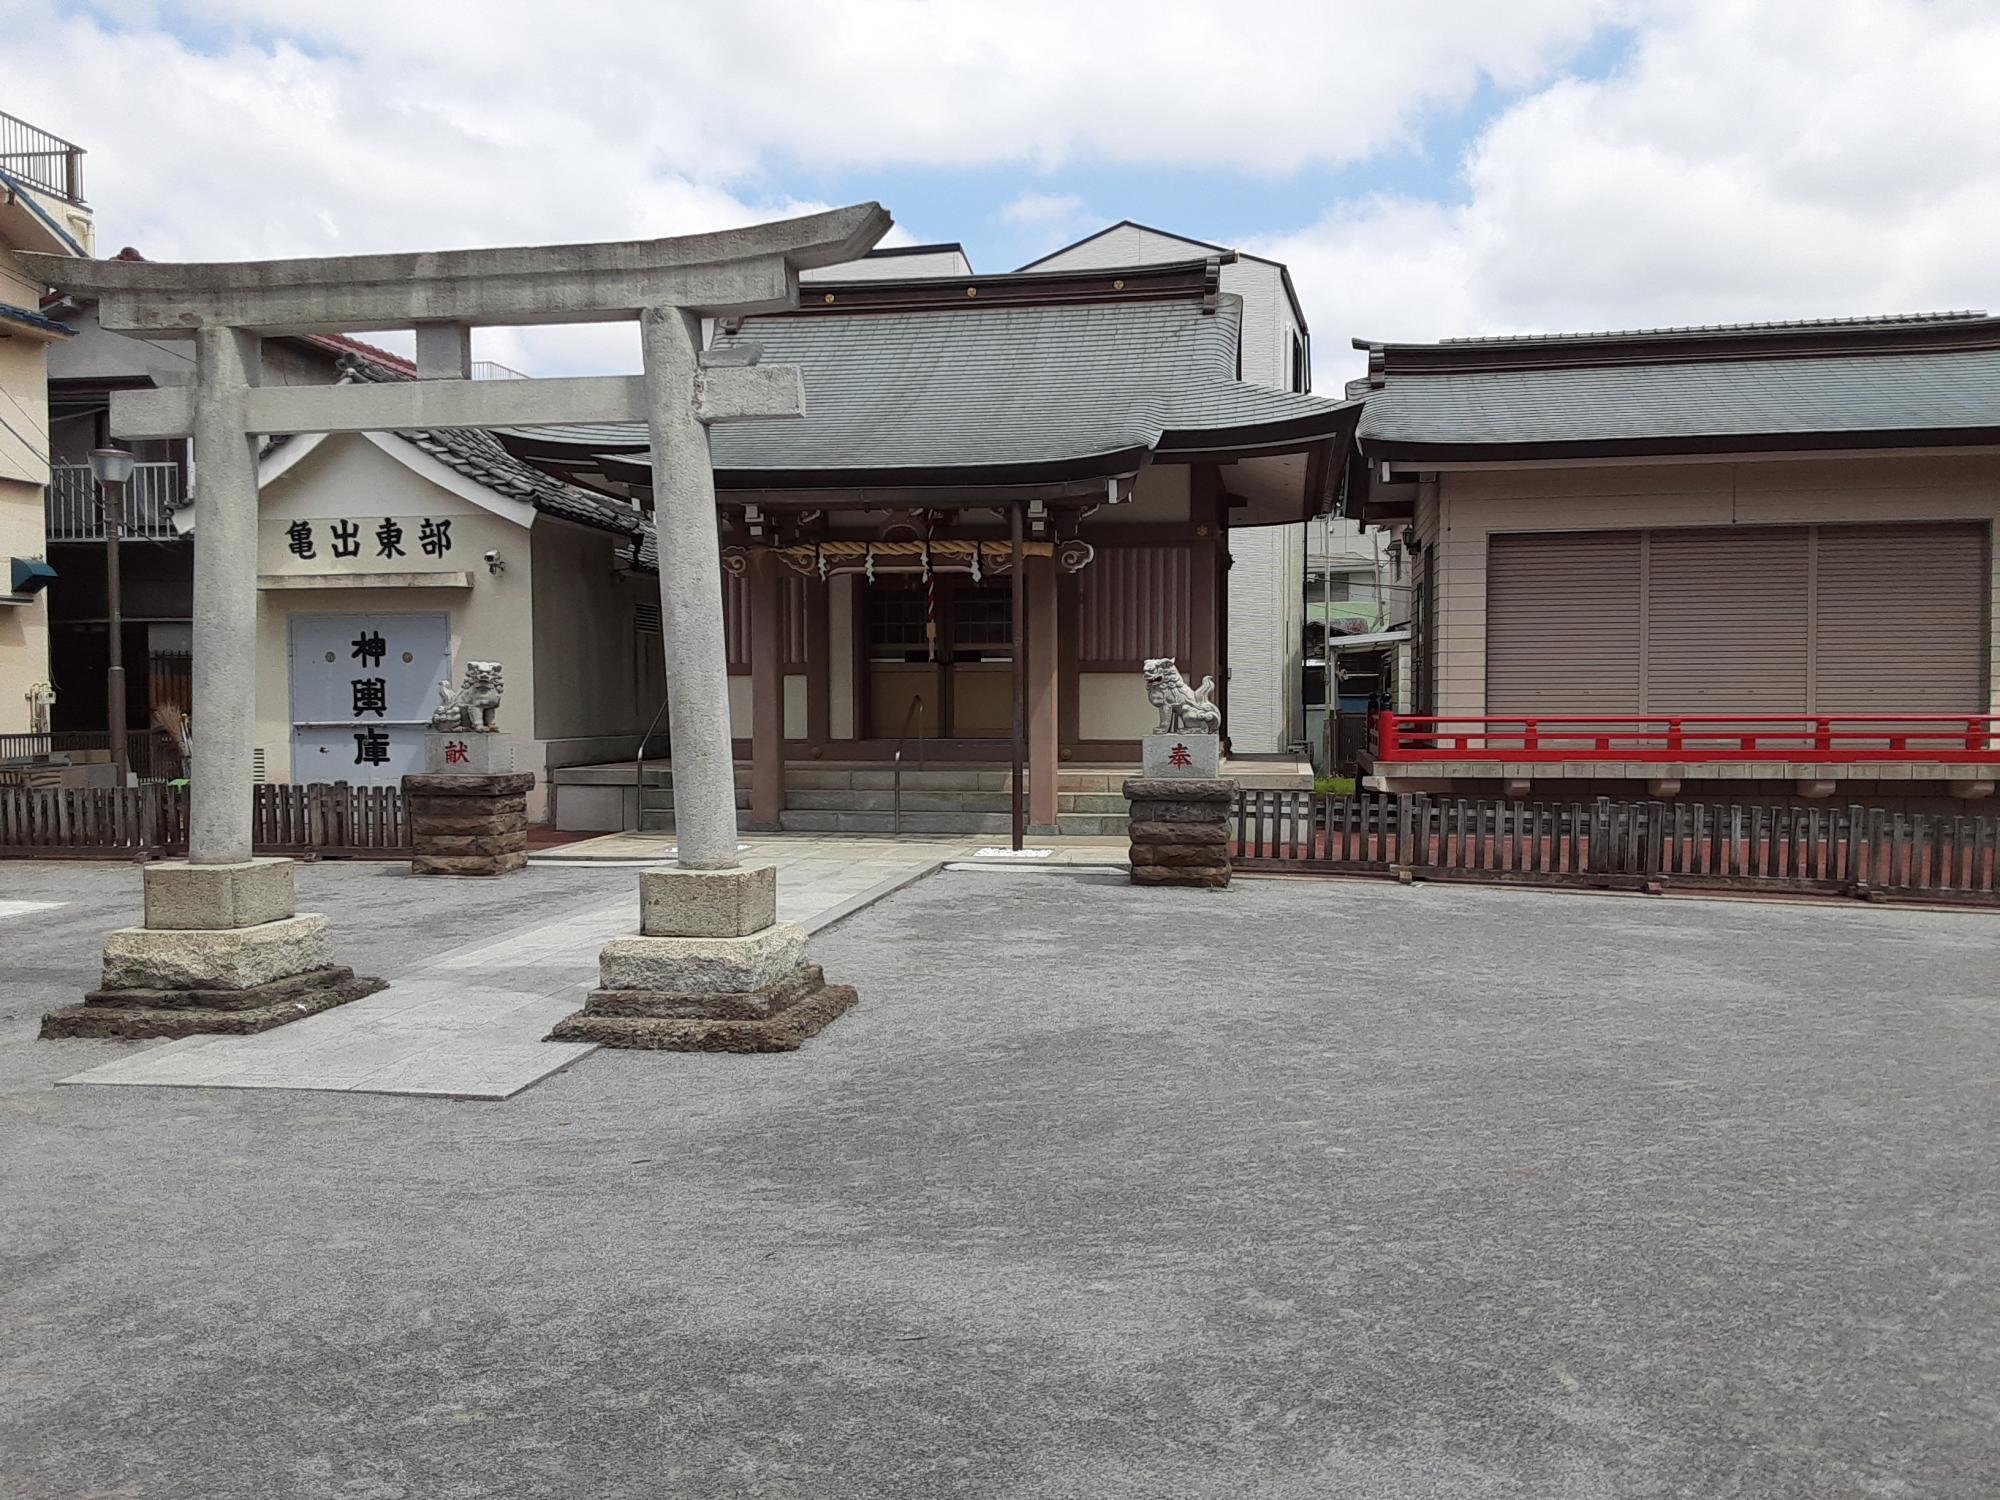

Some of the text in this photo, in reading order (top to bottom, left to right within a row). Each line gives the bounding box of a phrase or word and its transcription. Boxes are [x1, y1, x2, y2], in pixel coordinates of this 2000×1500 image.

[285, 517, 452, 560] 亀出東部
[351, 630, 391, 767] 神輿庫
[444, 741, 470, 765] 献
[1167, 742, 1193, 771] 奉
